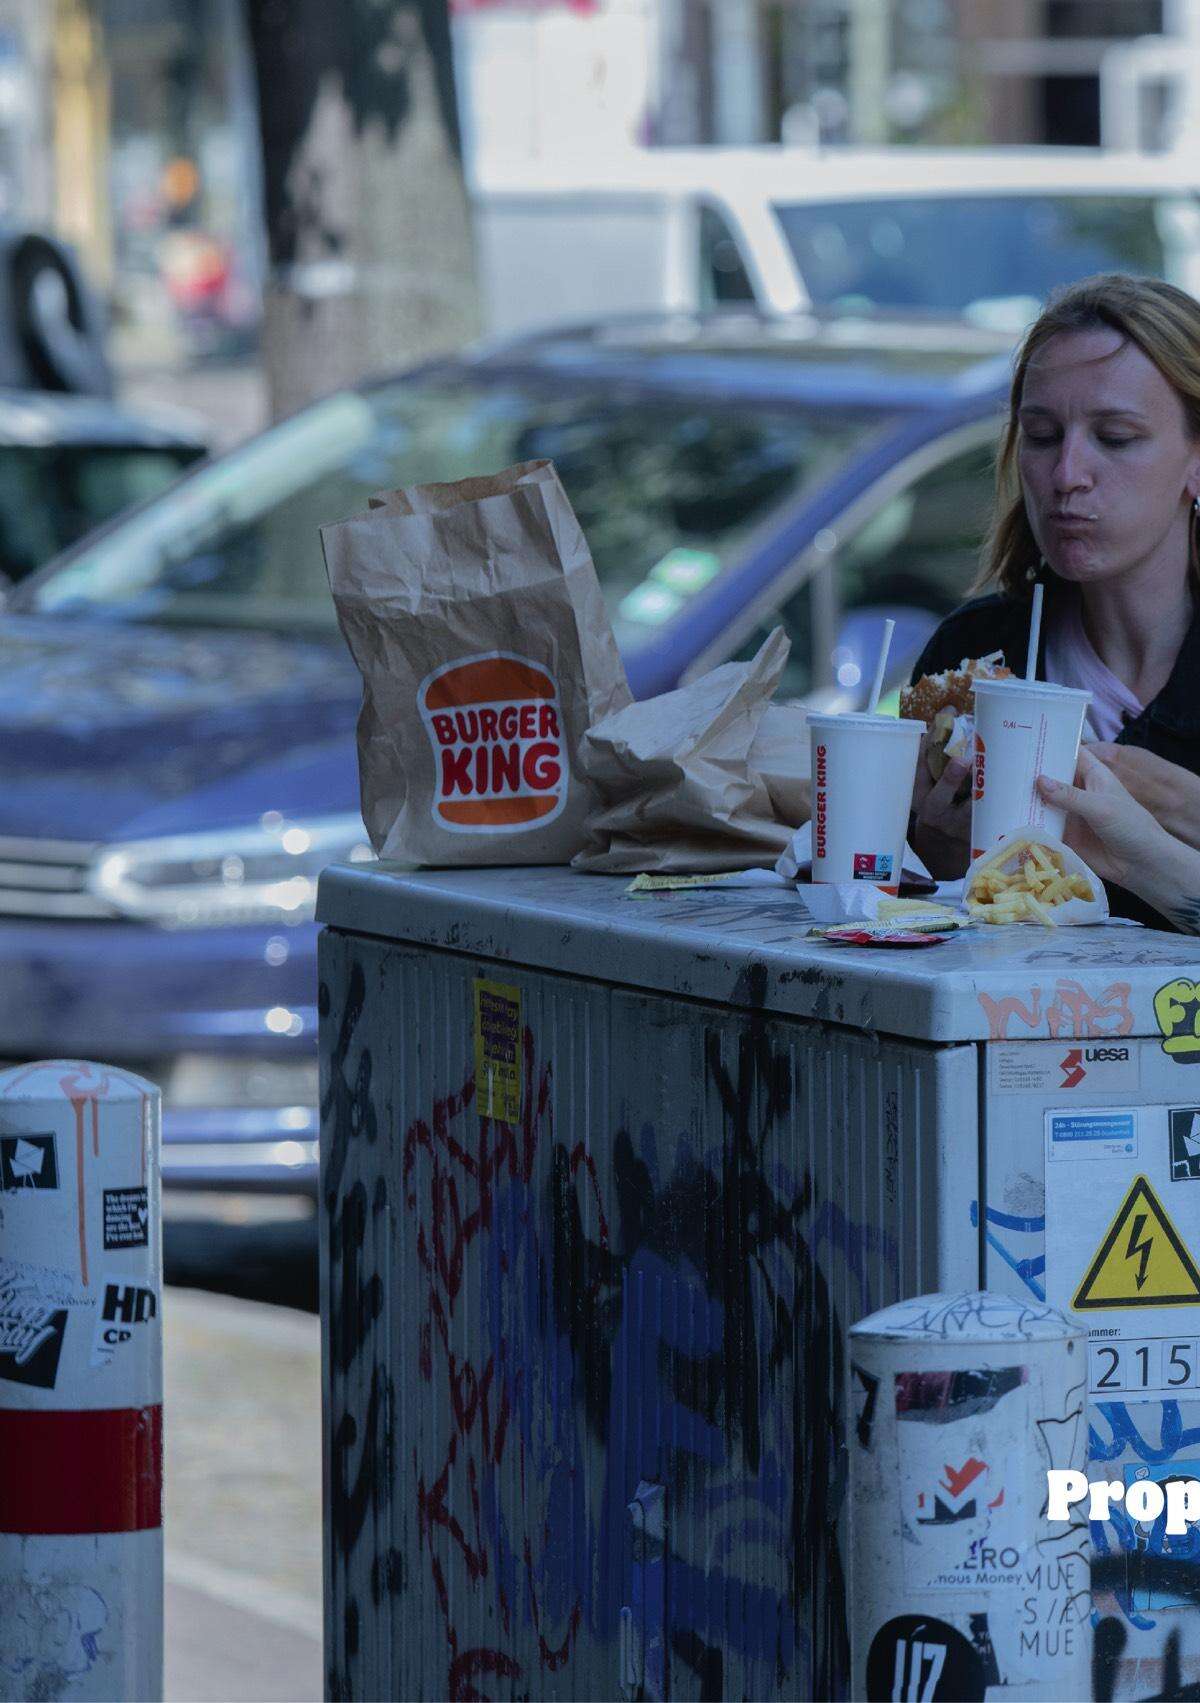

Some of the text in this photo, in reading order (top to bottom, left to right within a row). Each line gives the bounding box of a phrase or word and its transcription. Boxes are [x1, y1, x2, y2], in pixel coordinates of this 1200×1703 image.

[431, 704, 560, 745] BURGER
[441, 742, 561, 796] KING
[816, 744, 827, 859] BURGER KING
[1085, 1047, 1129, 1063] uesa
[955, 1547, 1020, 1570] ERO
[975, 1572, 1023, 1586] Money
[1020, 1628, 1074, 1657] MUE
